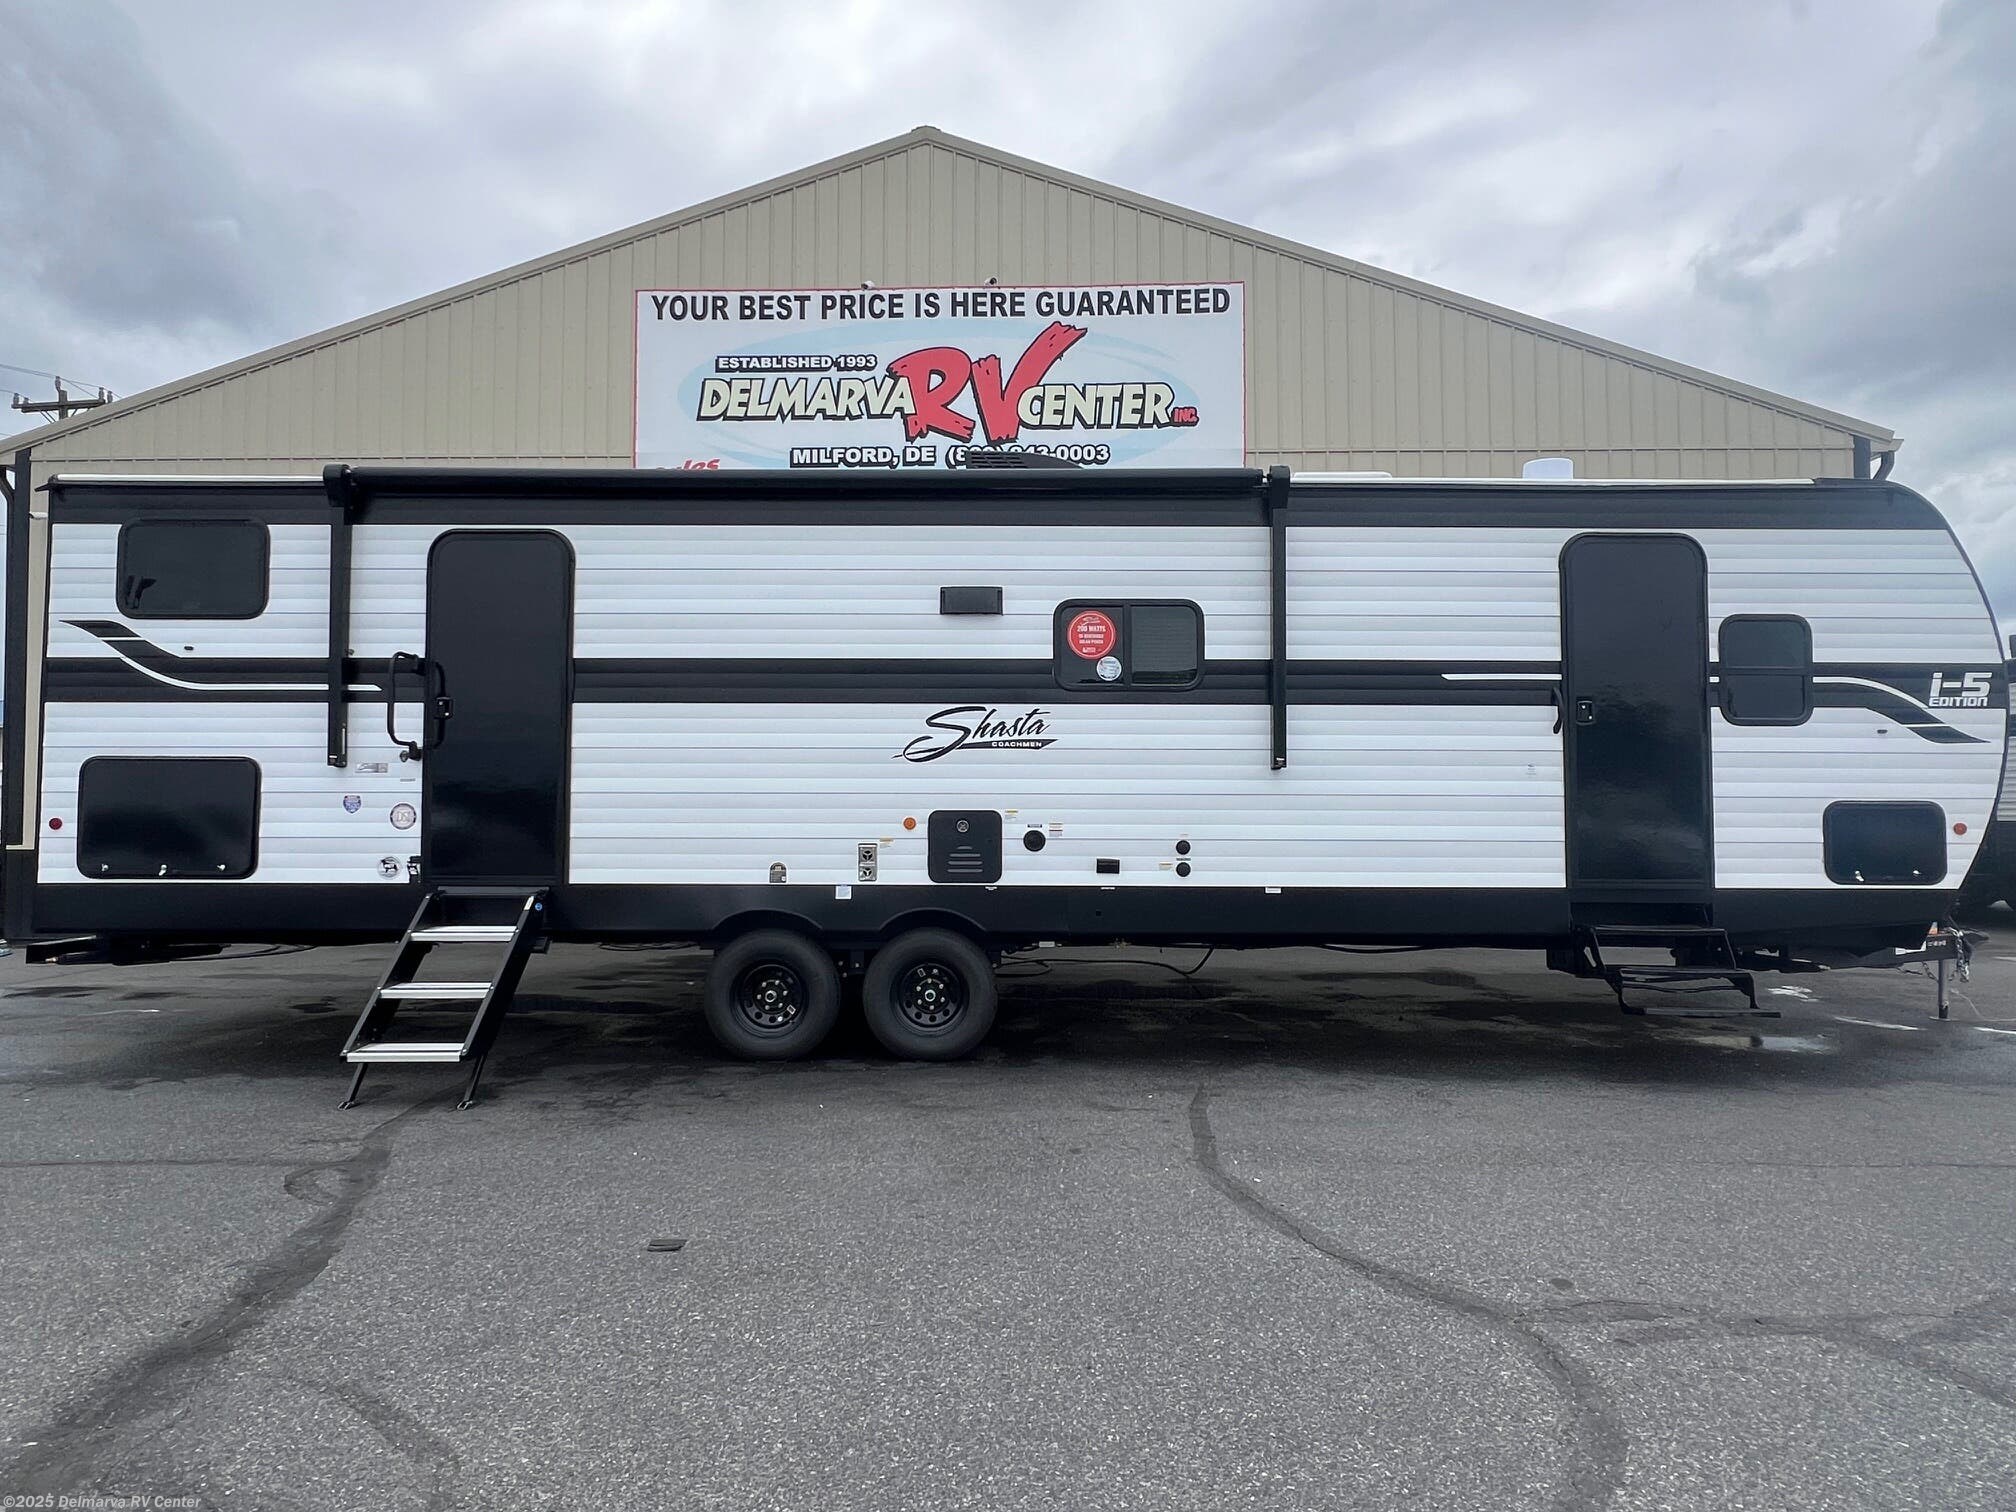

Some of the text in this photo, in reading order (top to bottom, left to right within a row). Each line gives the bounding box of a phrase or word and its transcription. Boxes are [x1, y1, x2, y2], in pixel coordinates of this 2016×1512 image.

[651, 287, 1231, 321] YOUR BEST PRICE IS HERE GUARANTEED
[717, 355, 877, 370] ESTABLISHED 1993
[697, 320, 1199, 443] DELMARVA RV CENTER INC.
[790, 446, 900, 466] MILFORD,
[904, 446, 936, 464] DE
[1928, 696, 1988, 707] EDITION
[902, 705, 1052, 763] Shasta
